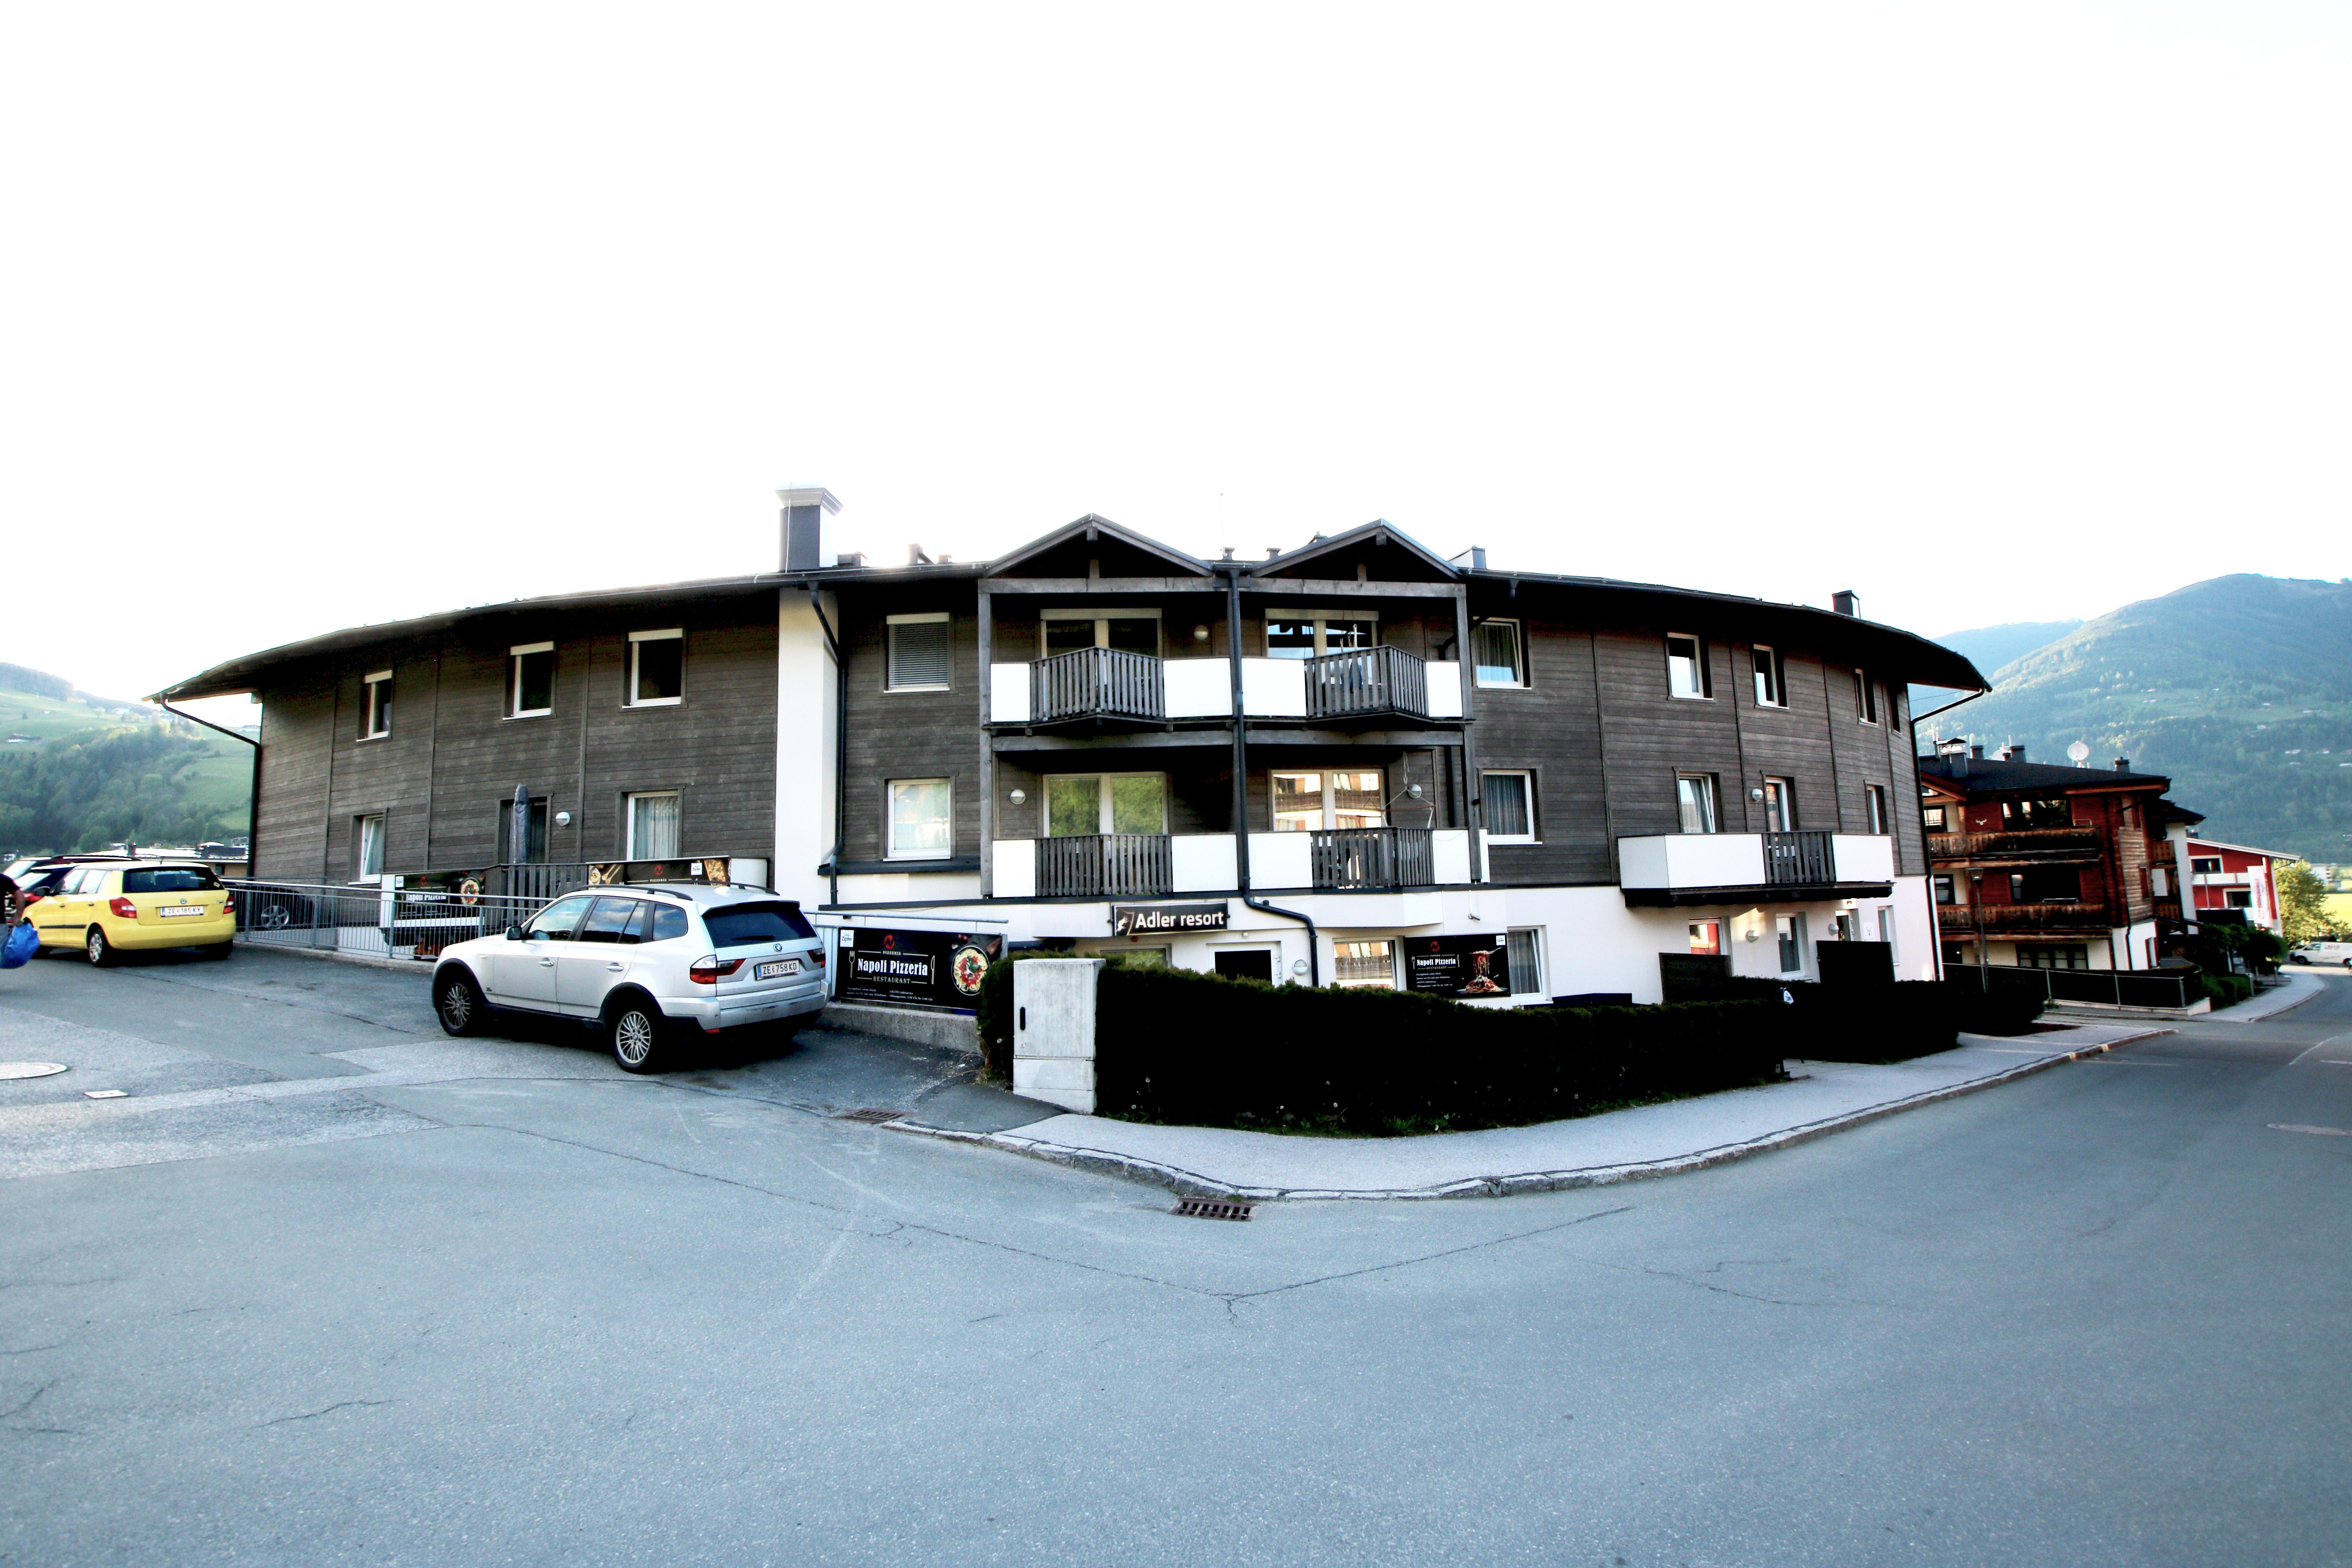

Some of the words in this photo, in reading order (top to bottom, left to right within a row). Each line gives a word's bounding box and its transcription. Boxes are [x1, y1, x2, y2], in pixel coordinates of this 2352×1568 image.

[1135, 911, 1176, 928] Adler
[1180, 911, 1223, 926] resort
[762, 965, 771, 975] ZE
[776, 964, 788, 973] 758
[789, 962, 797, 971] KD
[857, 958, 887, 973] Napoli
[890, 960, 928, 976] Pizzeria
